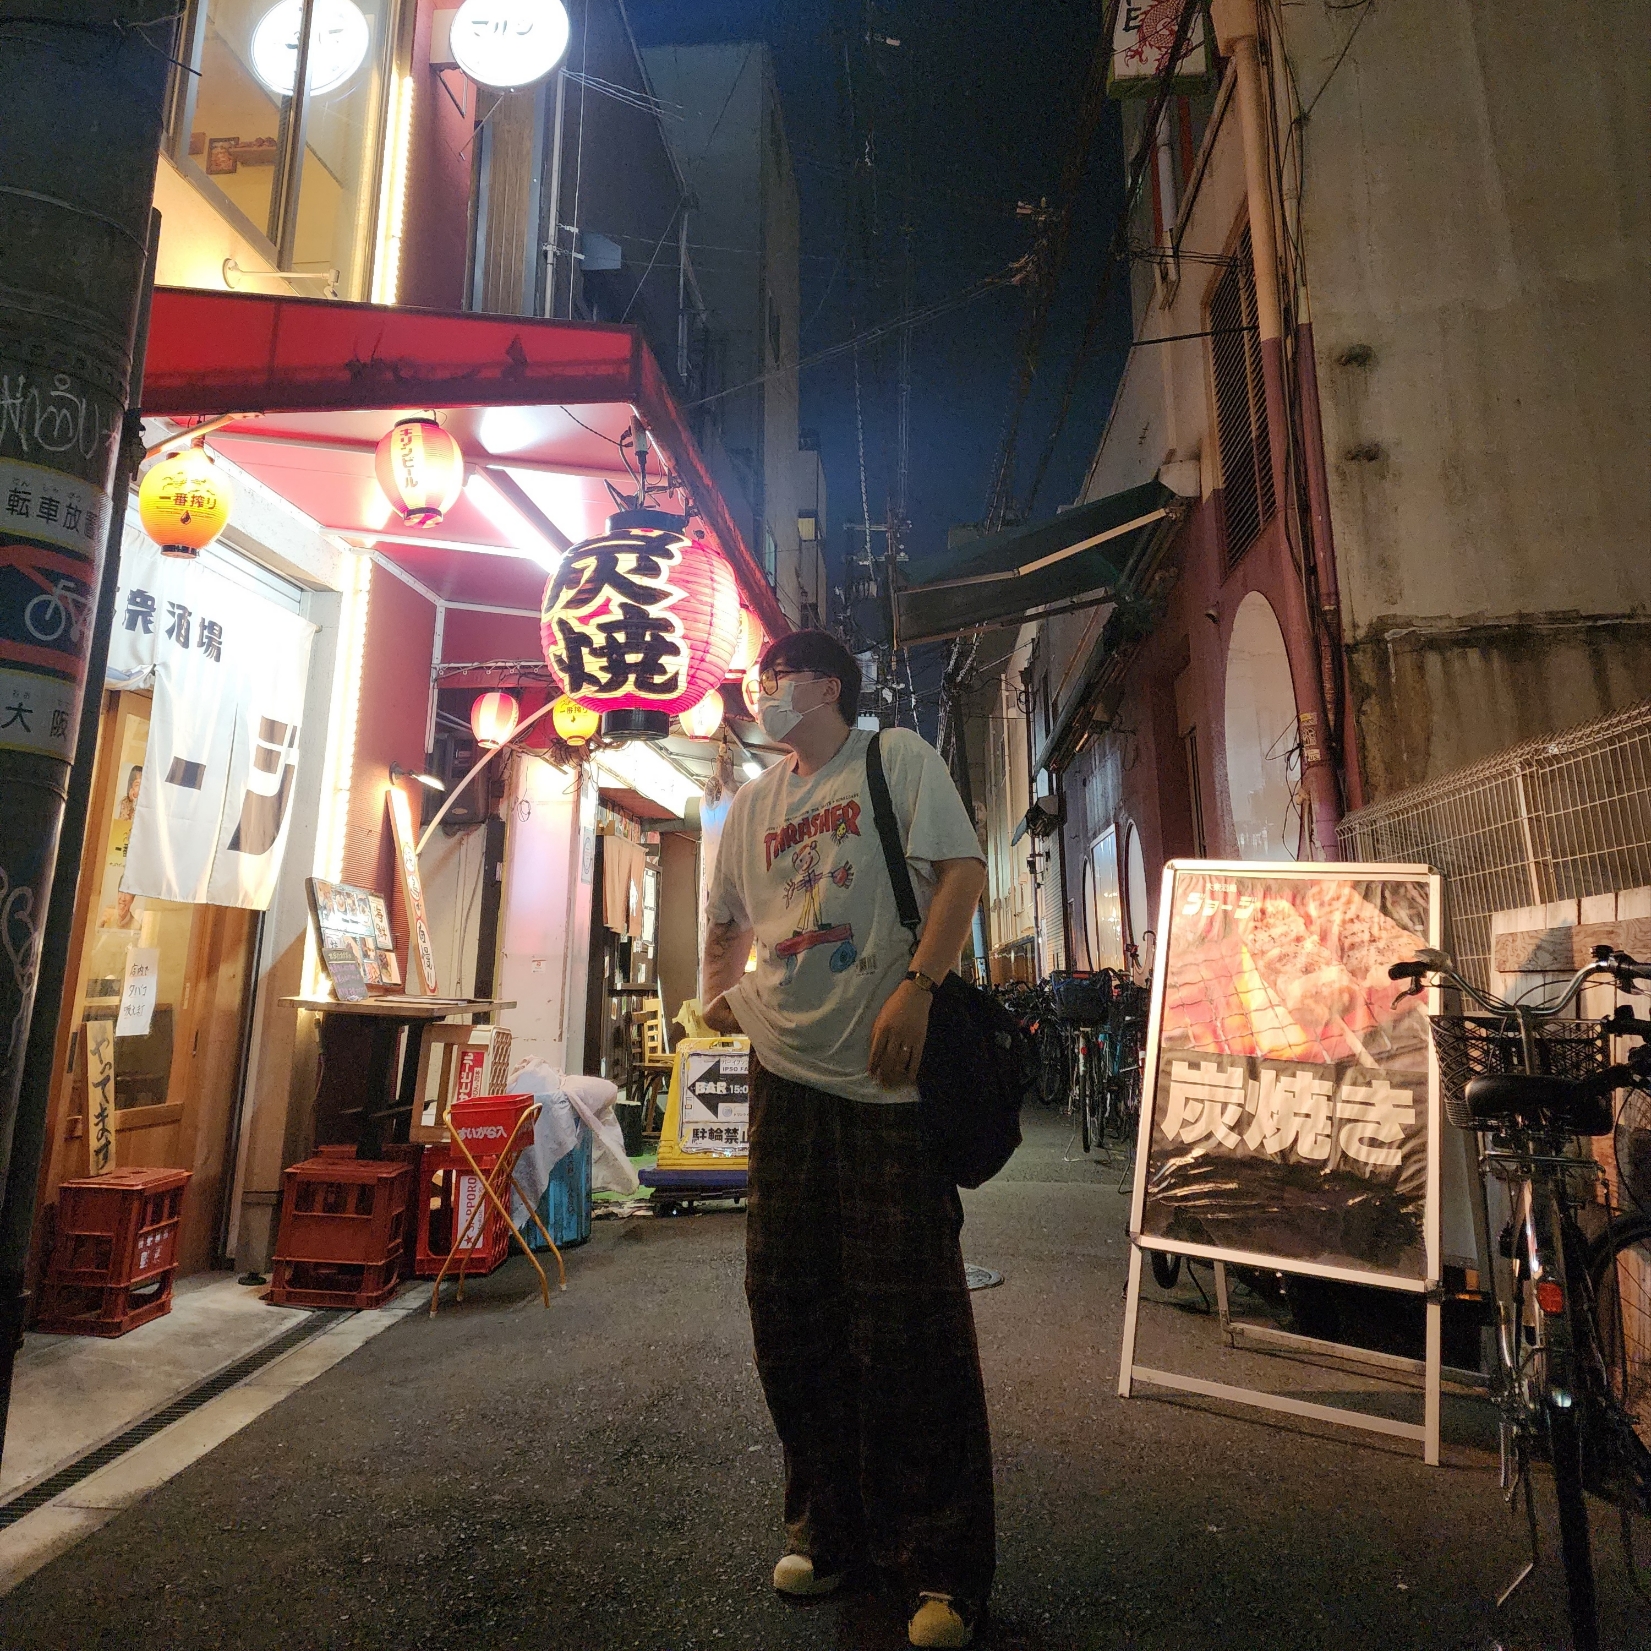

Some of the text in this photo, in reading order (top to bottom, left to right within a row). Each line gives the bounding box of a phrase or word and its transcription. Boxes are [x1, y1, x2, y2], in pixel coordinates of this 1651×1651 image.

[399, 428, 418, 489] キリンビール
[158, 492, 217, 510] 一番搾り
[114, 586, 223, 664] 衆酒場
[763, 799, 862, 872] THRASHER
[1181, 891, 1257, 919] ジョージ
[89, 1037, 113, 1171] やってます
[695, 1081, 727, 1096] BAR
[1160, 1060, 1416, 1166] 炭焼き
[465, 1177, 477, 1232] SPPORO
